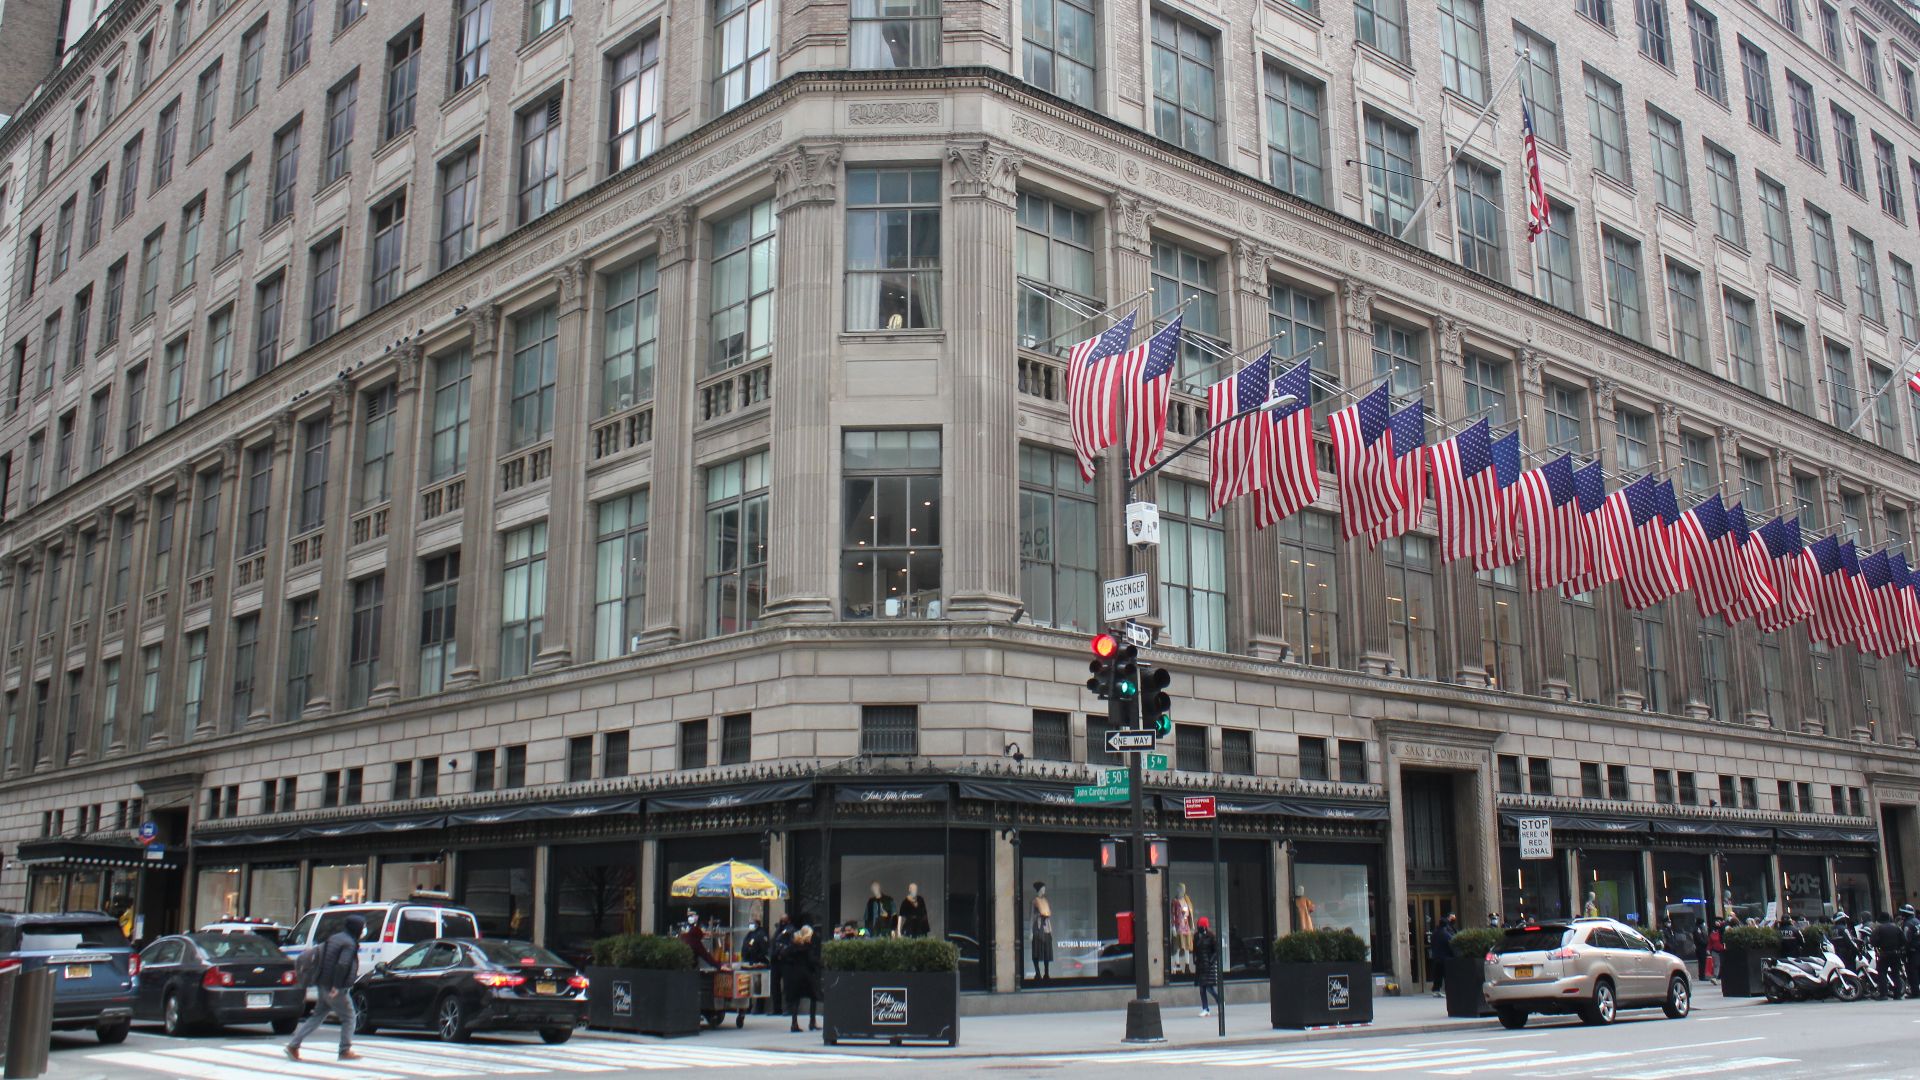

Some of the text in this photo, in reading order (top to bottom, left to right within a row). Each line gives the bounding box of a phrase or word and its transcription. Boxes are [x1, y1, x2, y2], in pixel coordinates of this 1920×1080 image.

[1107, 580, 1145, 598] PASSENGER
[1107, 596, 1145, 614] CARS ONLY
[1113, 737, 1149, 745] ONE WAY
[1405, 745, 1475, 760] SAKS & COMPANY
[1151, 756, 1155, 768] 5
[1106, 772, 1110, 784] E
[1112, 771, 1122, 783] 50
[861, 790, 923, 801] Saks Fifth Avenue
[1076, 787, 1129, 797] John Cardinal O'Connor
[1521, 819, 1548, 830] STOP
[1523, 847, 1550, 855] SIGNAL
[873, 992, 895, 1006] Saks
[889, 1001, 907, 1013] Fifth
[873, 1007, 904, 1021] Avenue
